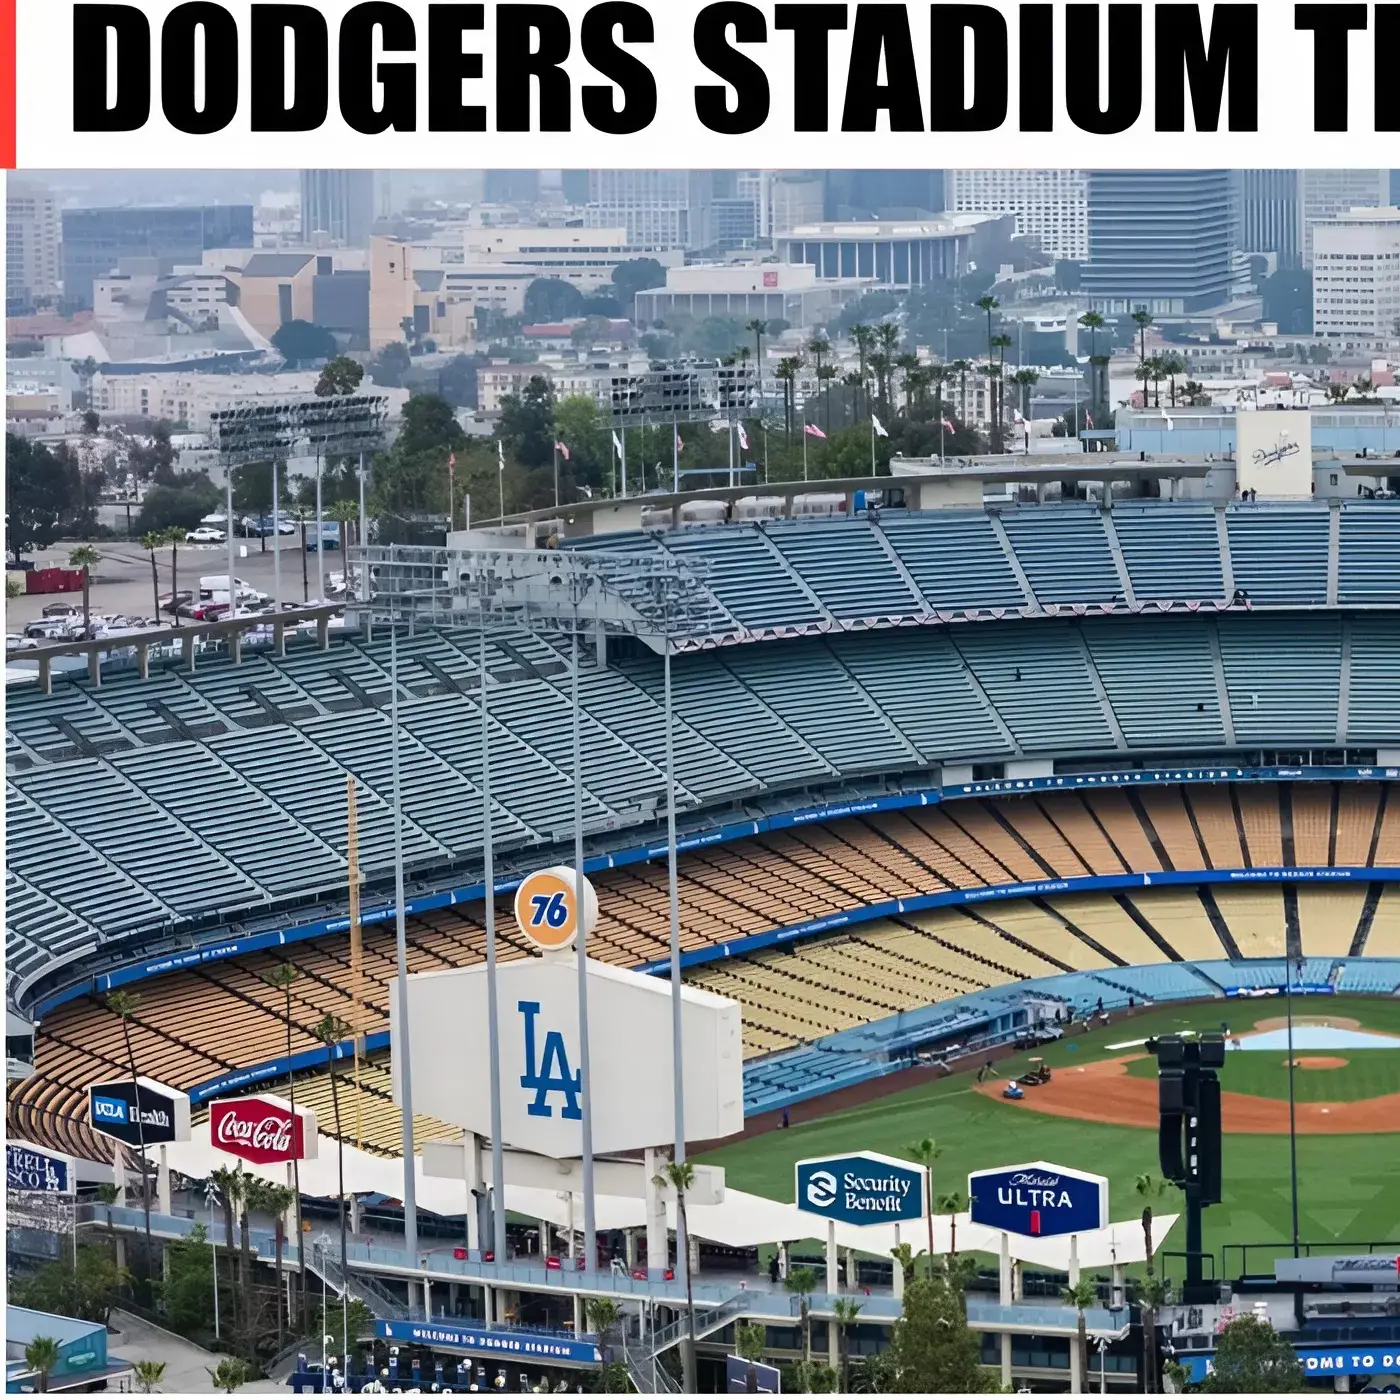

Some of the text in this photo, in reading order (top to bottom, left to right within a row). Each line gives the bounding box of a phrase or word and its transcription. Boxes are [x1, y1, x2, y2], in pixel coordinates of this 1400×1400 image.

[530, 892, 567, 928] 76
[517, 1000, 583, 1120] LA
[843, 1172, 911, 1197] Security
[997, 1186, 1073, 1209] ULTRA
[1352, 1355, 1375, 1367] TO
